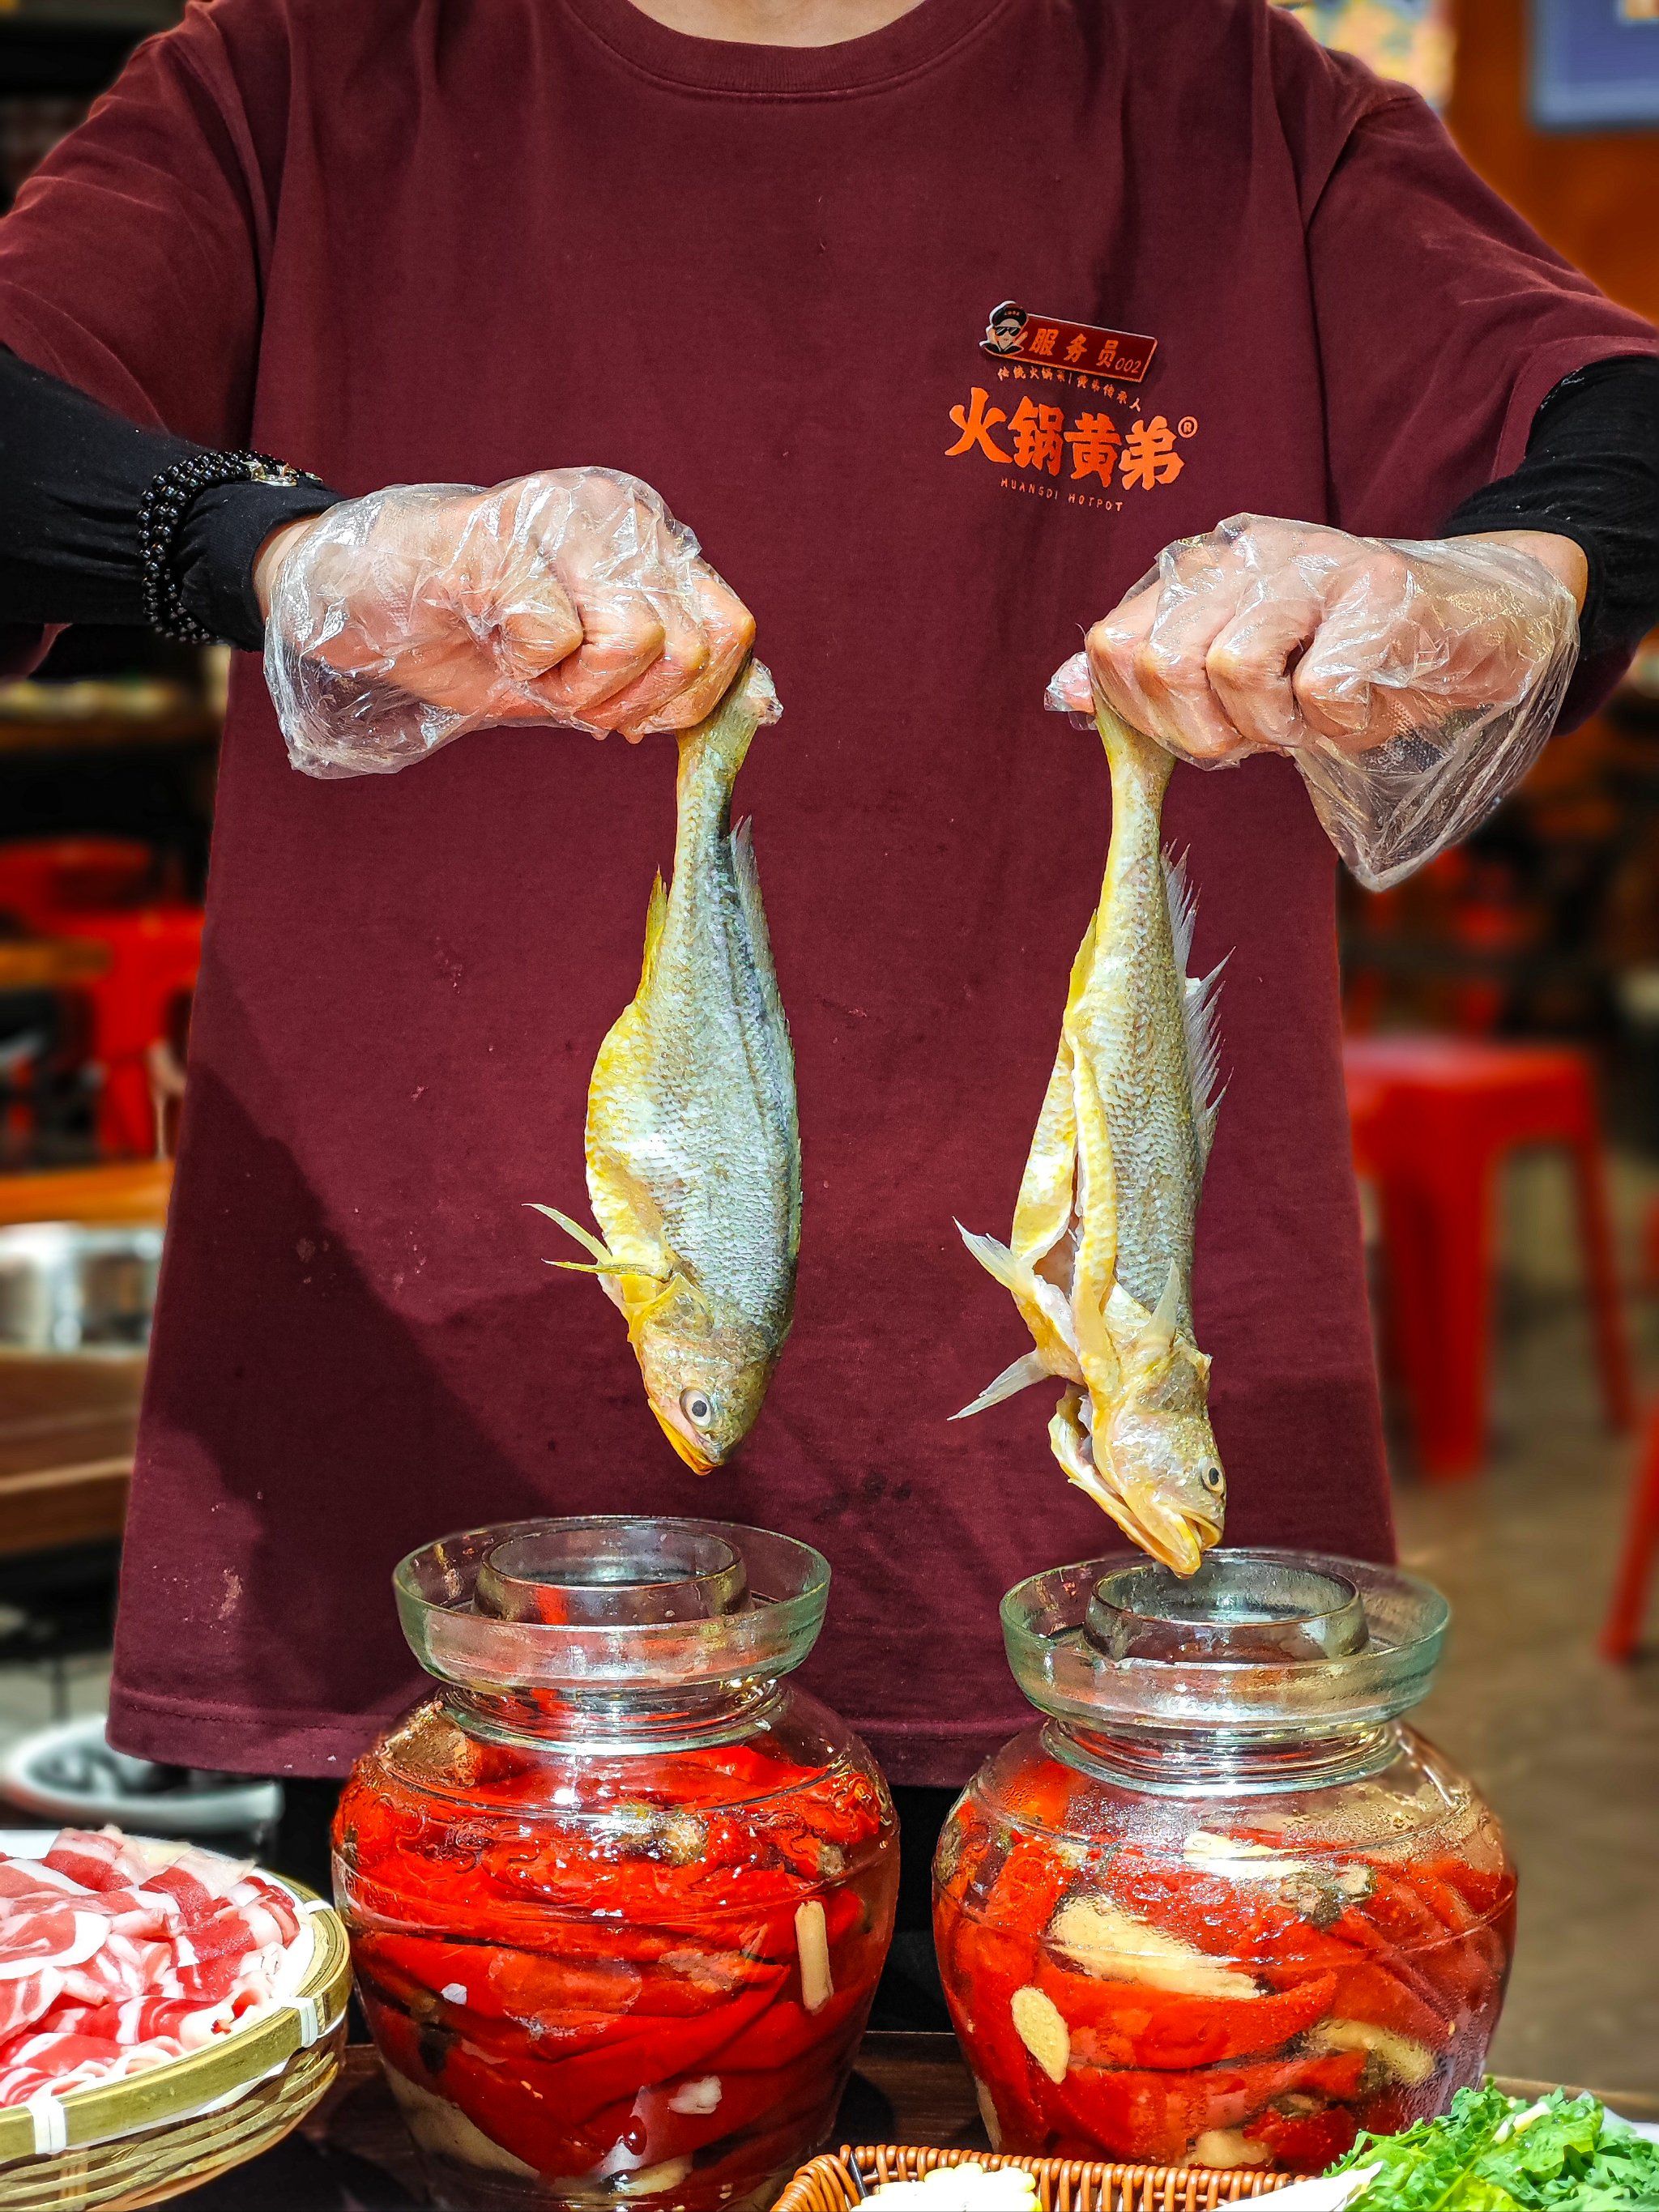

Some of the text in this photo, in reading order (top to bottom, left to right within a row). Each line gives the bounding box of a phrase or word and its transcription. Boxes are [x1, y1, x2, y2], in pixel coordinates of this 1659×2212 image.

[1028, 327, 1141, 374] 服务员 002
[944, 386, 1186, 492] 火锅黄弟
[1000, 477, 1124, 512] HUANGDI HOTPOT
